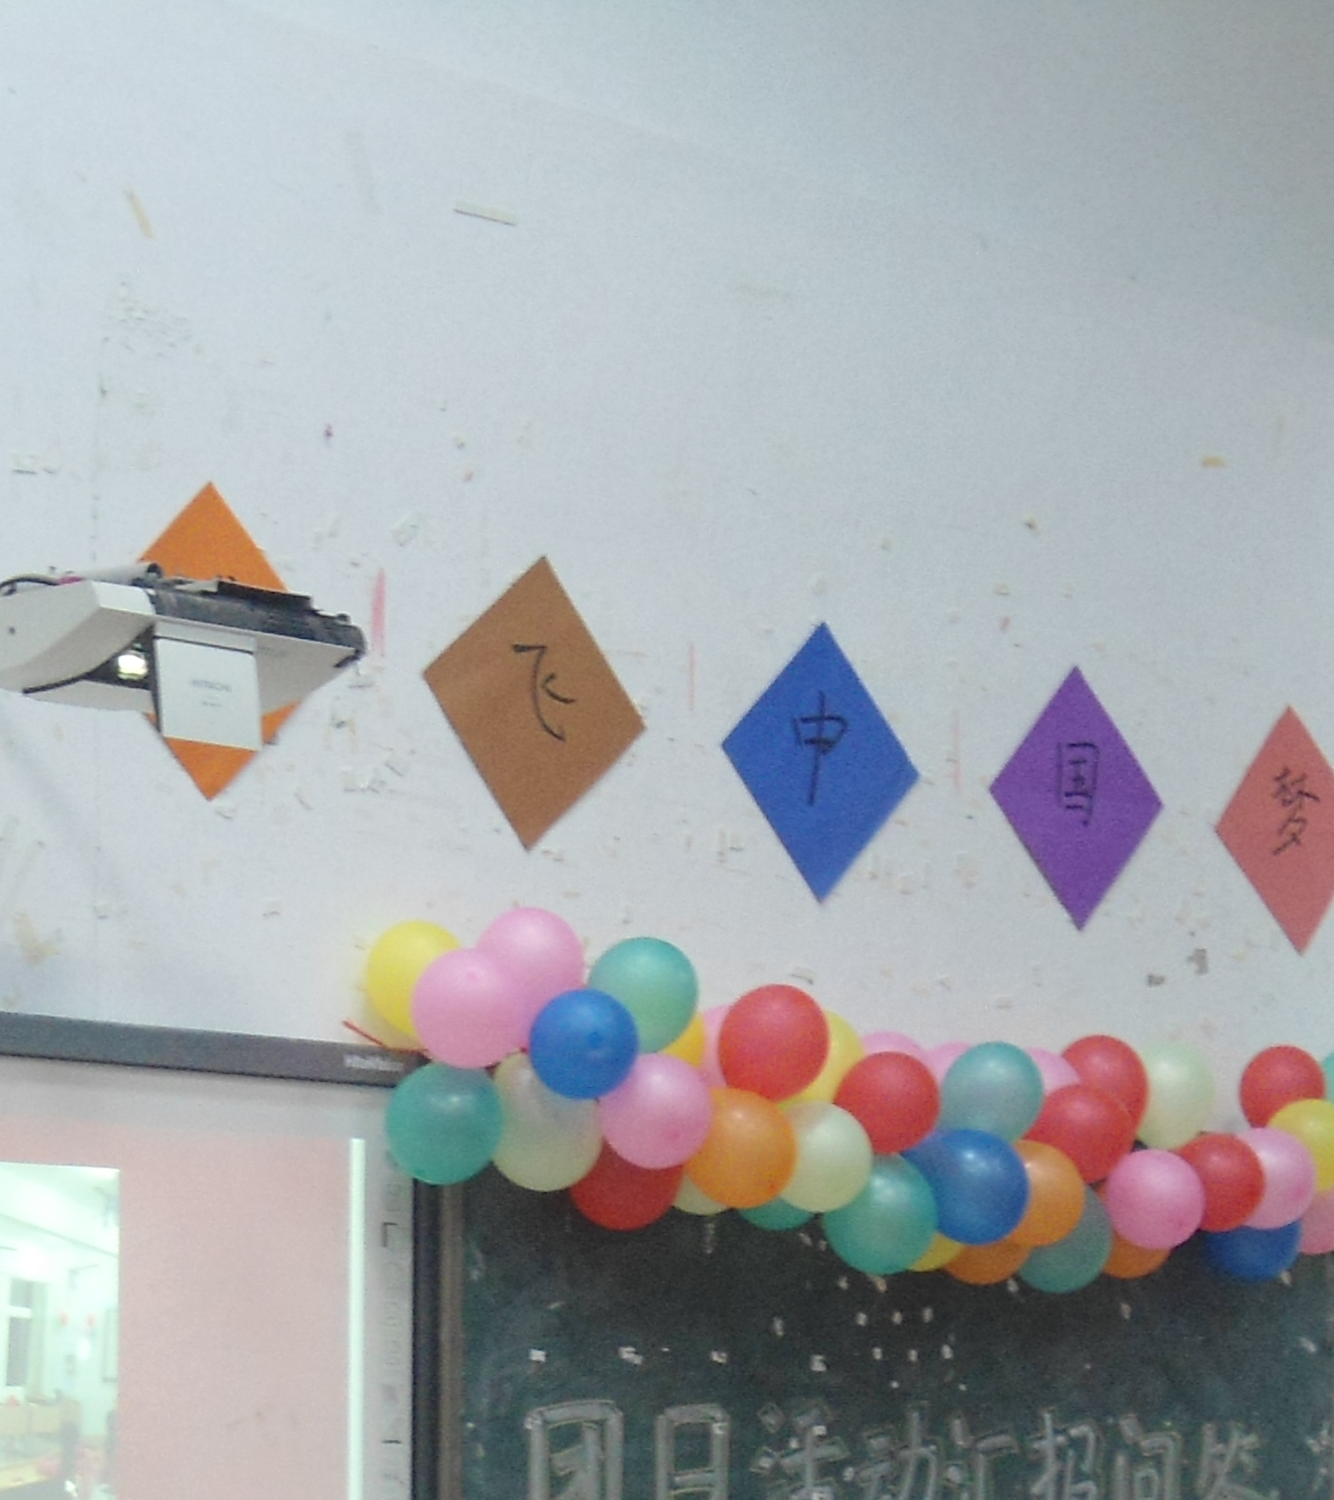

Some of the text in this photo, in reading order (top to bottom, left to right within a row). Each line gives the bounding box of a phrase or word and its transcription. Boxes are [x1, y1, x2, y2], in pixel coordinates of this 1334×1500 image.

[511, 643, 577, 743] 飞
[790, 690, 849, 807] 中
[1055, 739, 1101, 829] 国
[1271, 765, 1322, 857] 梦
